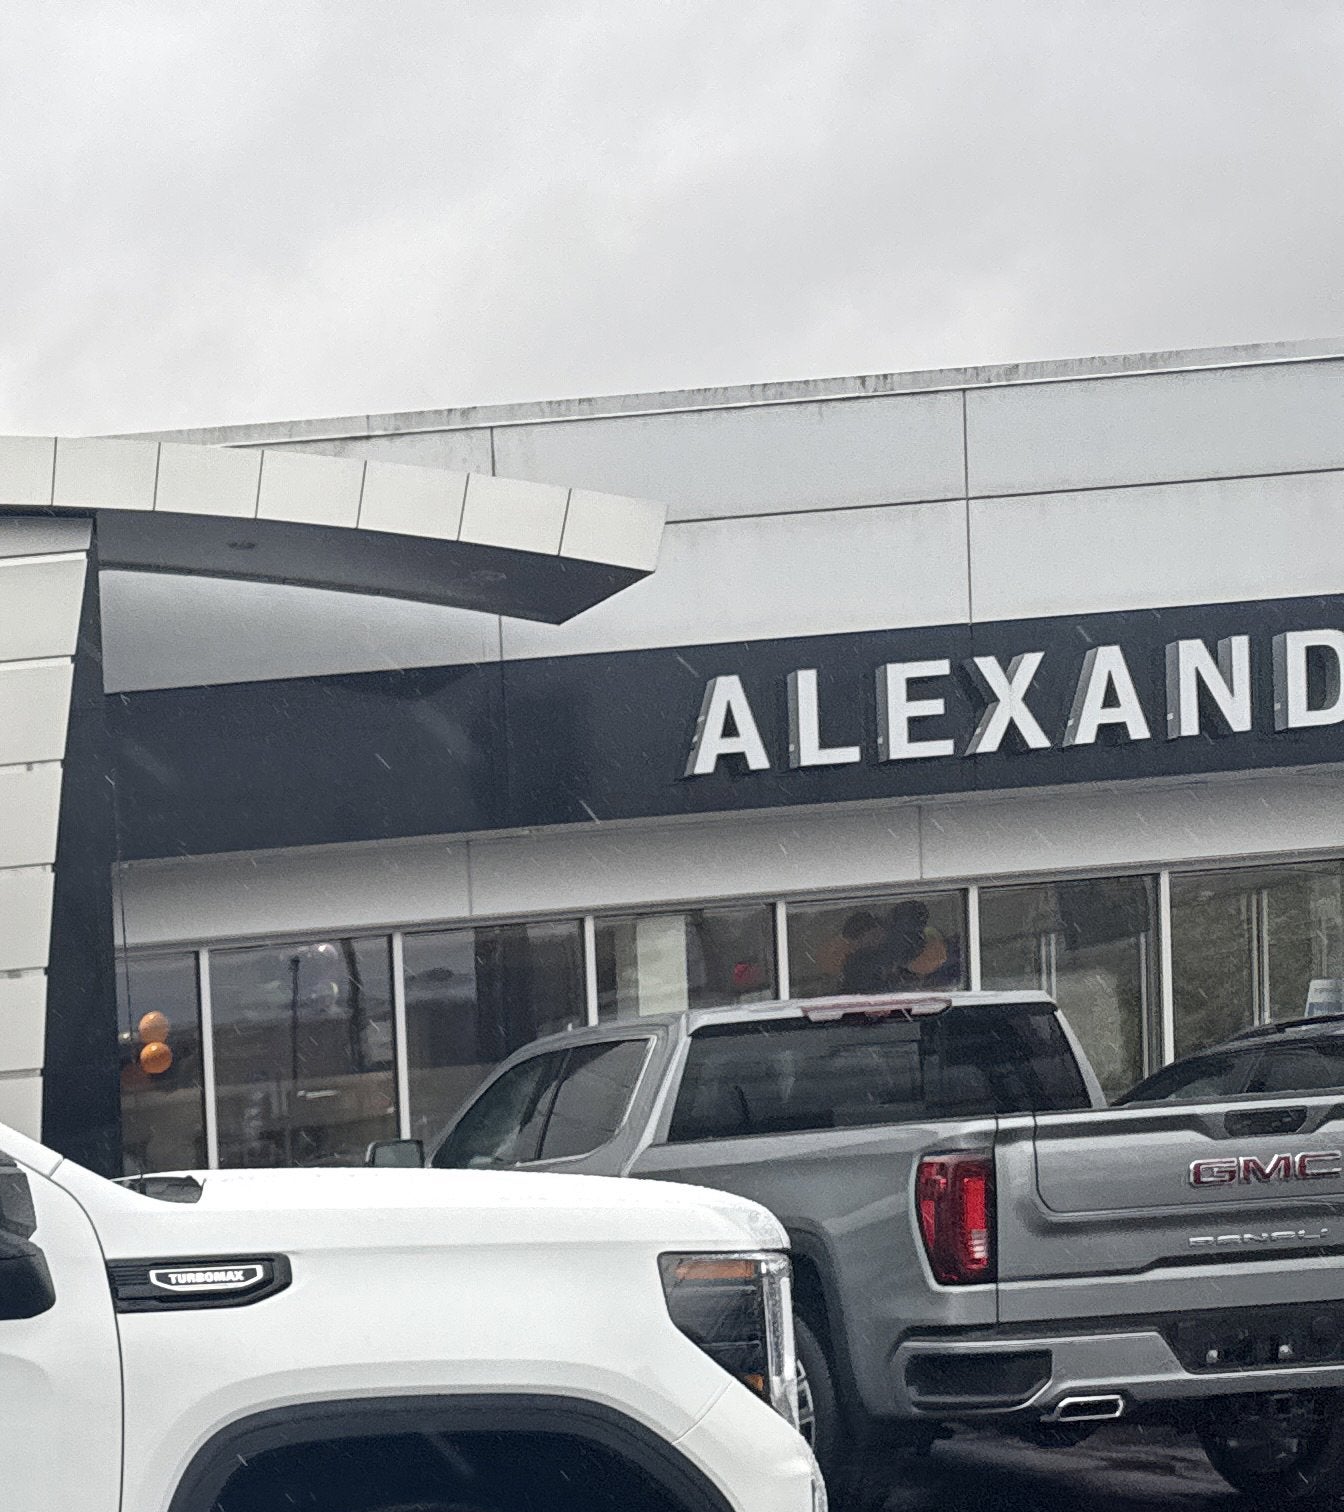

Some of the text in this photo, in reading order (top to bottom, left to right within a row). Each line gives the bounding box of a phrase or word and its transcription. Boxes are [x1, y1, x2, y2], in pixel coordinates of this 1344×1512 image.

[686, 628, 1344, 776] ALEXAND
[1189, 1151, 1343, 1187] GMC
[167, 1270, 245, 1285] TURBOMAX
